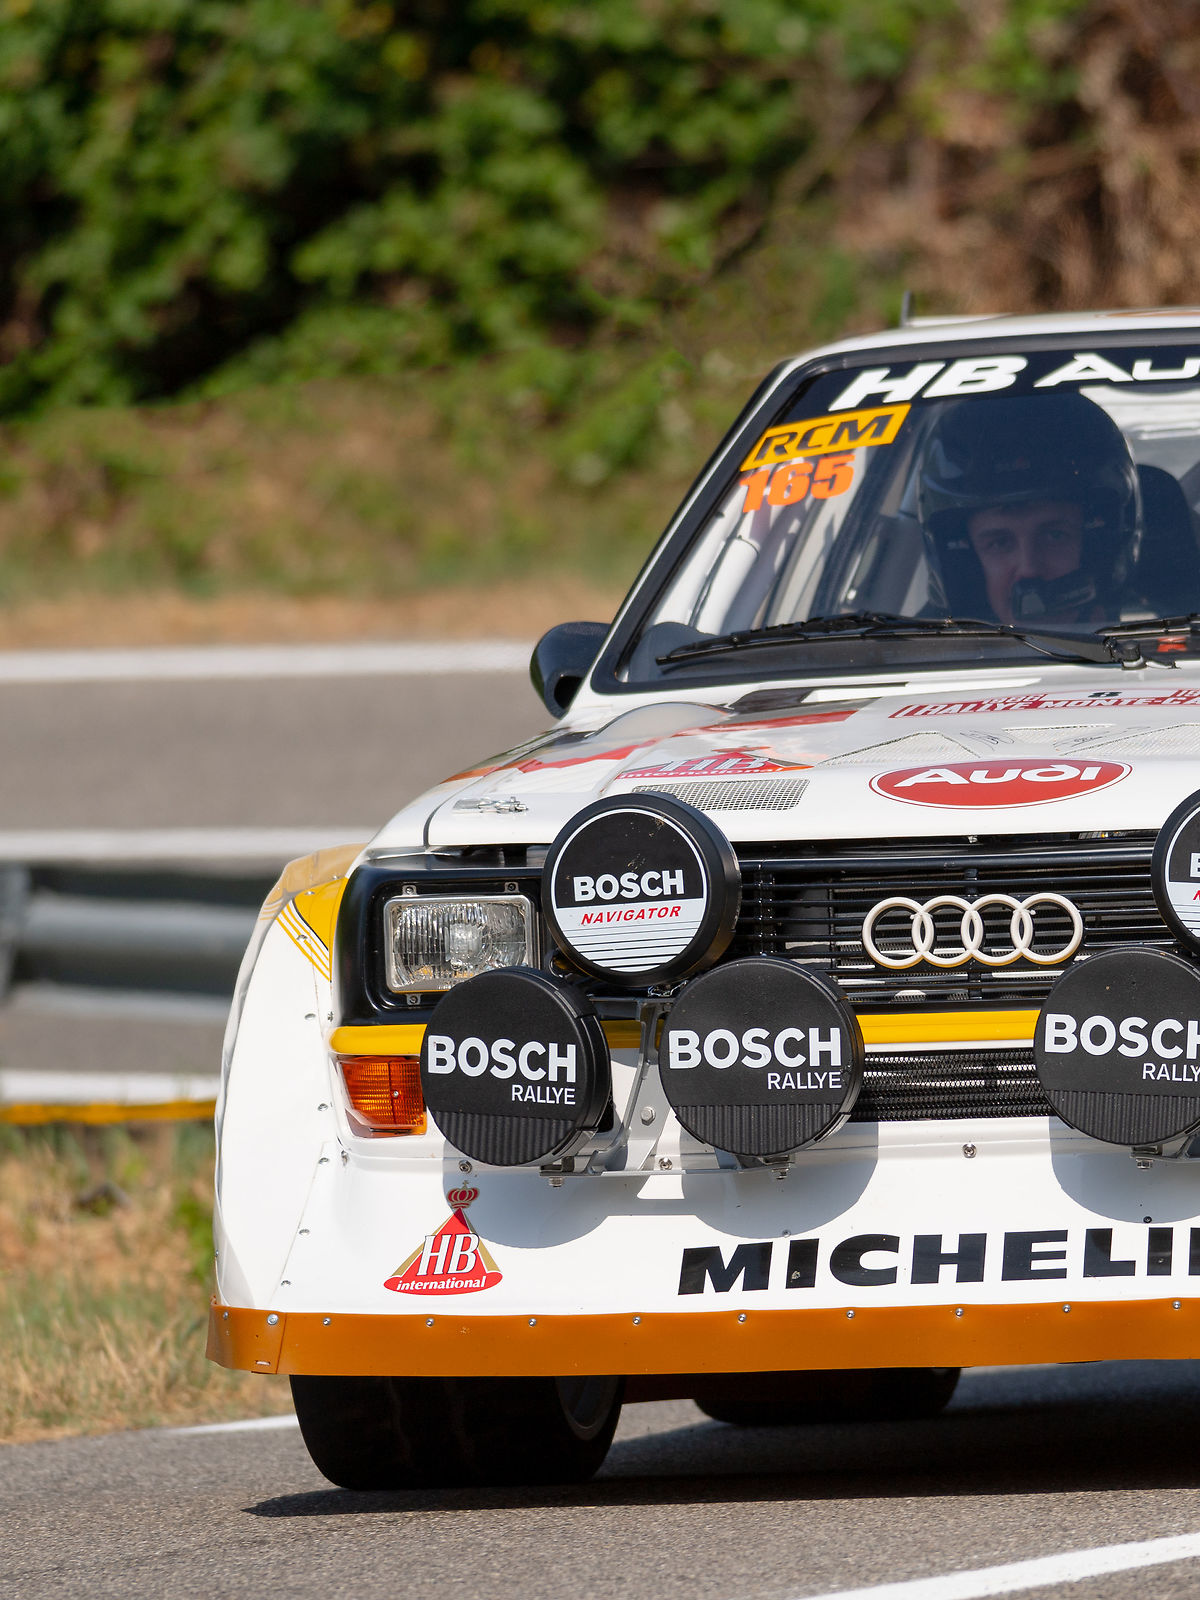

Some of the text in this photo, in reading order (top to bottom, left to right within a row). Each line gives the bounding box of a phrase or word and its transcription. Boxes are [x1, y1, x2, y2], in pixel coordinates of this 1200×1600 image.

[829, 355, 1028, 411] HB
[754, 413, 892, 461] RCM
[740, 454, 855, 513] 165
[912, 700, 1034, 717] RALLYE
[658, 757, 771, 773] HB
[893, 764, 1103, 788] Audi
[573, 868, 685, 902] BOSCH
[581, 905, 682, 925] NAVIGATOR
[427, 1034, 576, 1083] BOSCH
[668, 1027, 842, 1069] BOSCH
[511, 1084, 576, 1105] RALLYE
[767, 1071, 842, 1090] RALLYE
[416, 1232, 480, 1278] HB
[396, 1273, 487, 1292] international
